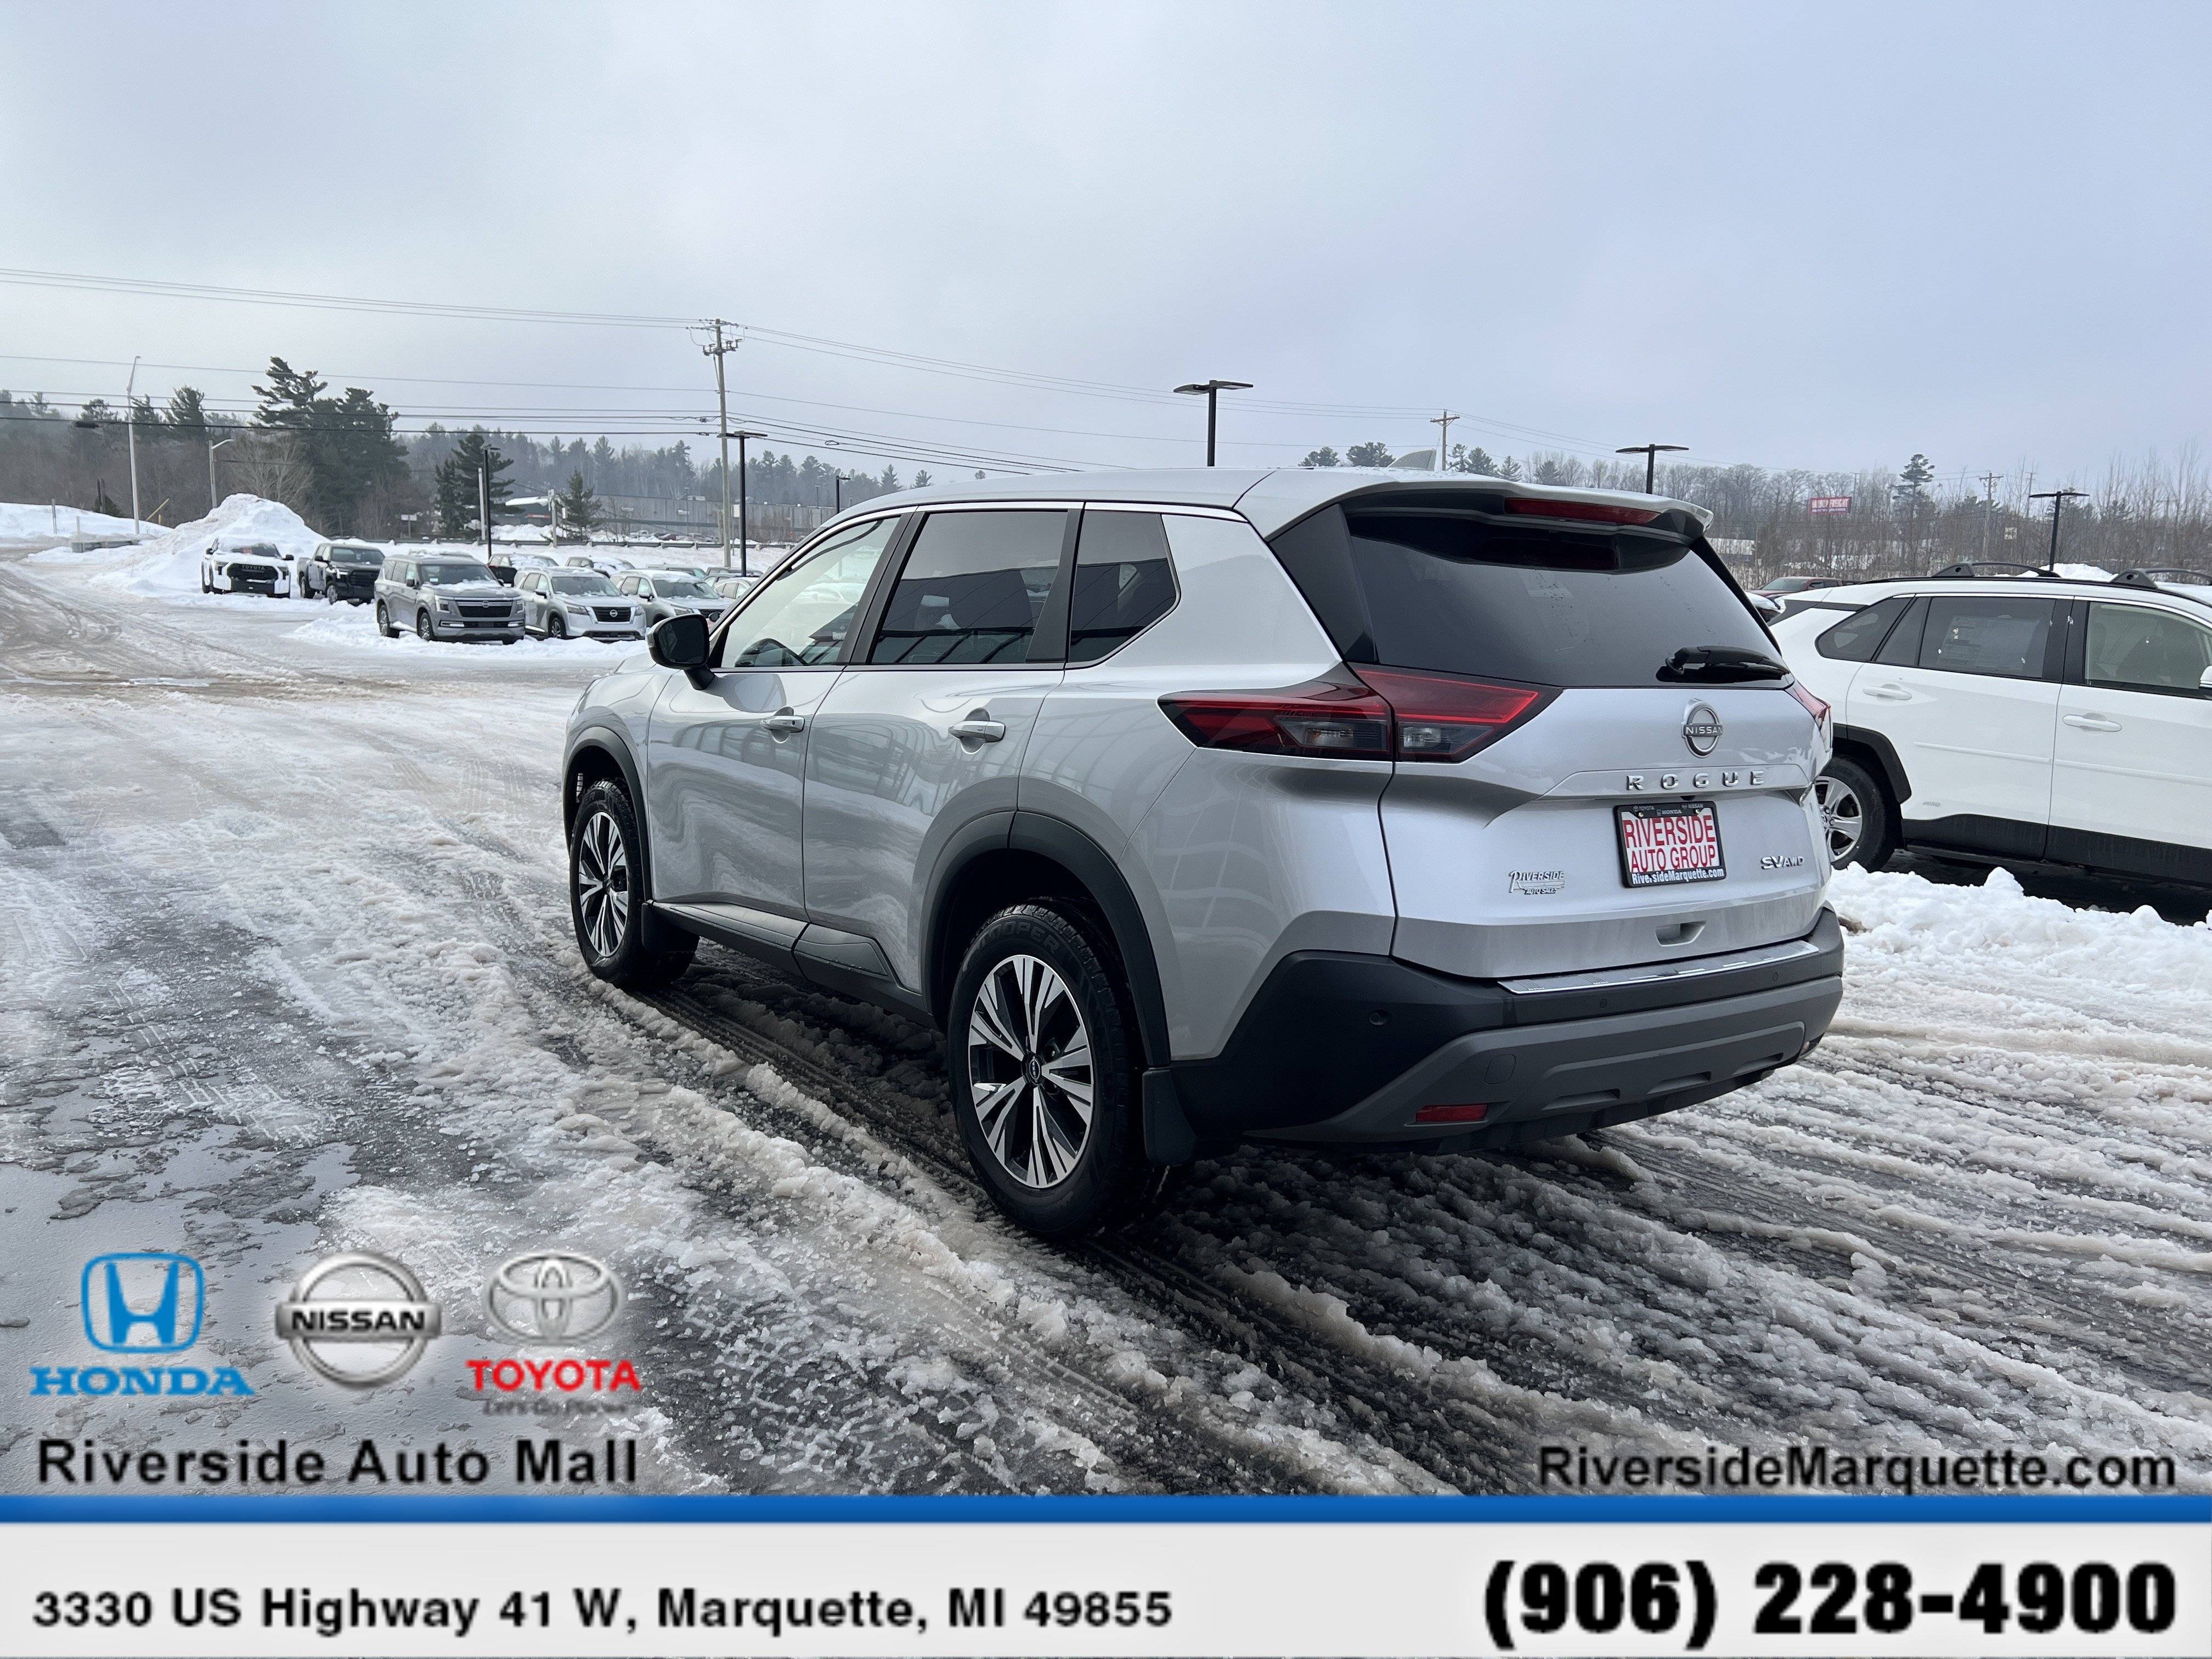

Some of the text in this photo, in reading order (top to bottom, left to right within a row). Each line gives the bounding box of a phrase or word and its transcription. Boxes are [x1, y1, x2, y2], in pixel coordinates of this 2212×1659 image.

[1686, 726, 1723, 735] NISSAN
[1626, 770, 1765, 791] ROGUE
[1622, 815, 1716, 849] RIVERSIDE
[1631, 845, 1716, 873] AUTO GROUP
[1760, 855, 1804, 870] SV AWD
[1509, 870, 1565, 893] RIVERSIDE
